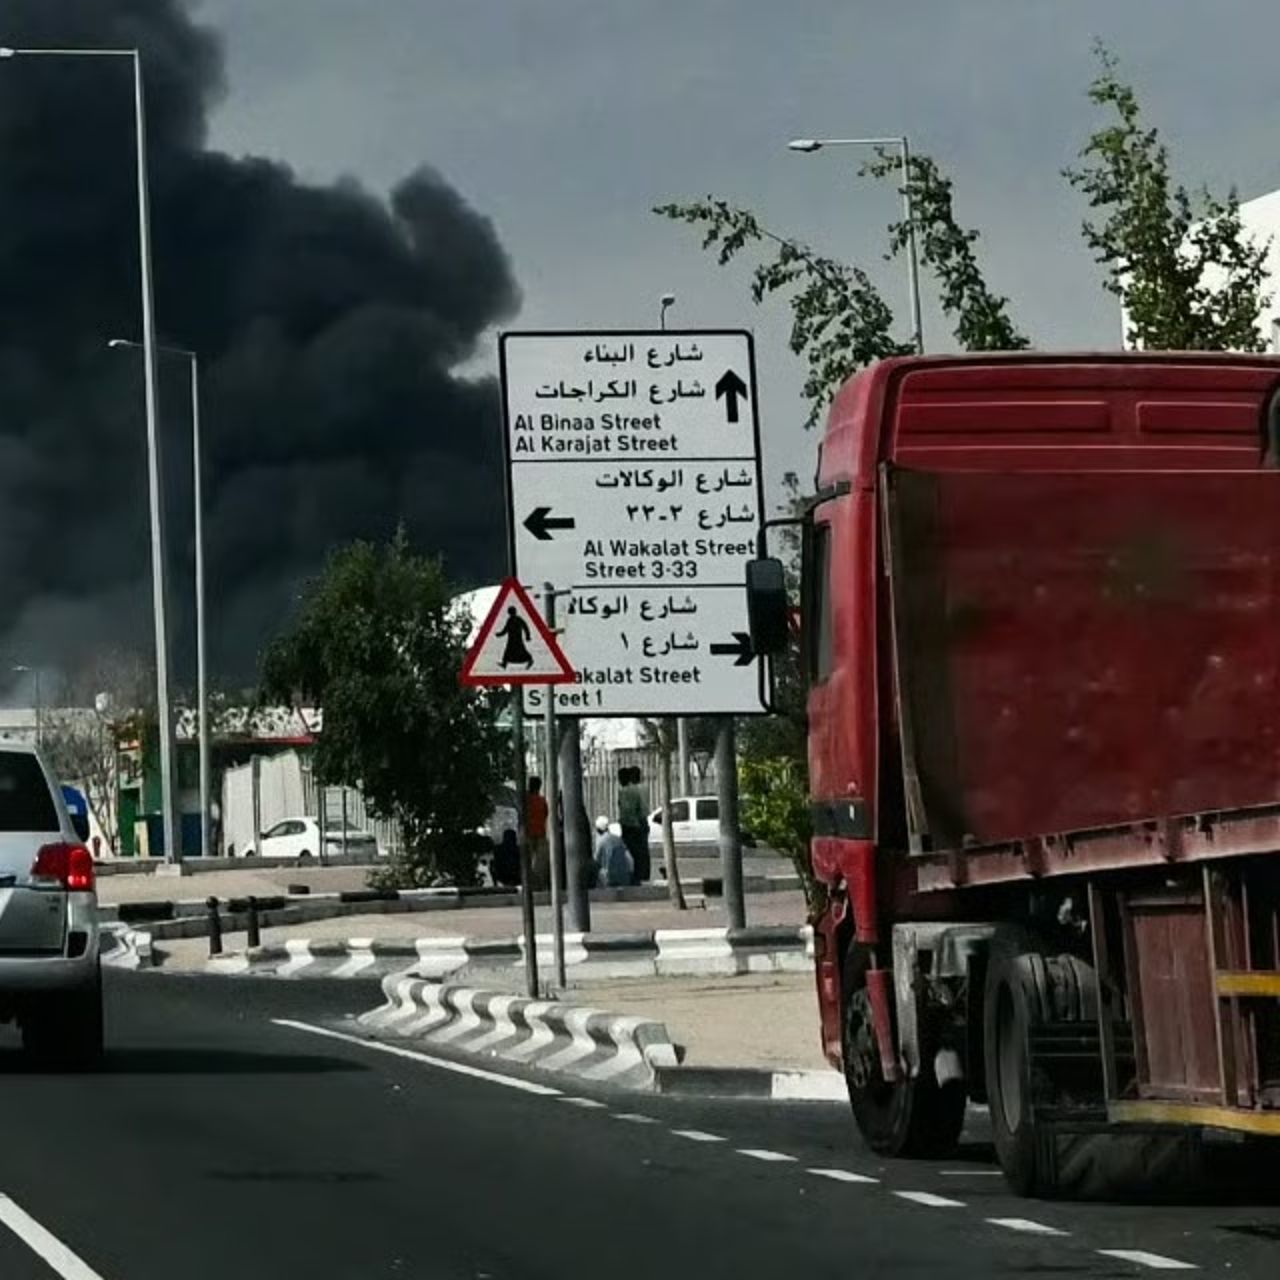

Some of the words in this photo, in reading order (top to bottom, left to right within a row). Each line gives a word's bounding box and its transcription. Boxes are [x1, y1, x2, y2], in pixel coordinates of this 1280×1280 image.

[584, 343, 634, 367] البناء
[647, 343, 703, 369] شارع
[535, 379, 637, 403] الكراجات
[649, 379, 705, 405] شارع
[514, 414, 535, 431] Al
[541, 413, 595, 431] Binaa
[601, 413, 661, 431] Street
[515, 435, 536, 453] Al
[541, 434, 611, 455] Karajat
[617, 434, 678, 452] Street
[595, 468, 683, 493] الوكالات
[696, 468, 753, 494] شارع
[698, 504, 755, 530] شارع
[583, 539, 605, 557] Al
[609, 539, 689, 557] Wakalat
[695, 539, 755, 556] Street
[585, 560, 646, 578] Street
[651, 560, 697, 578] 3-33
[641, 595, 697, 621] شارع
[643, 631, 699, 657] شارع
[575, 667, 633, 685] akalat
[640, 666, 701, 684] Street
[596, 689, 602, 706] 1
